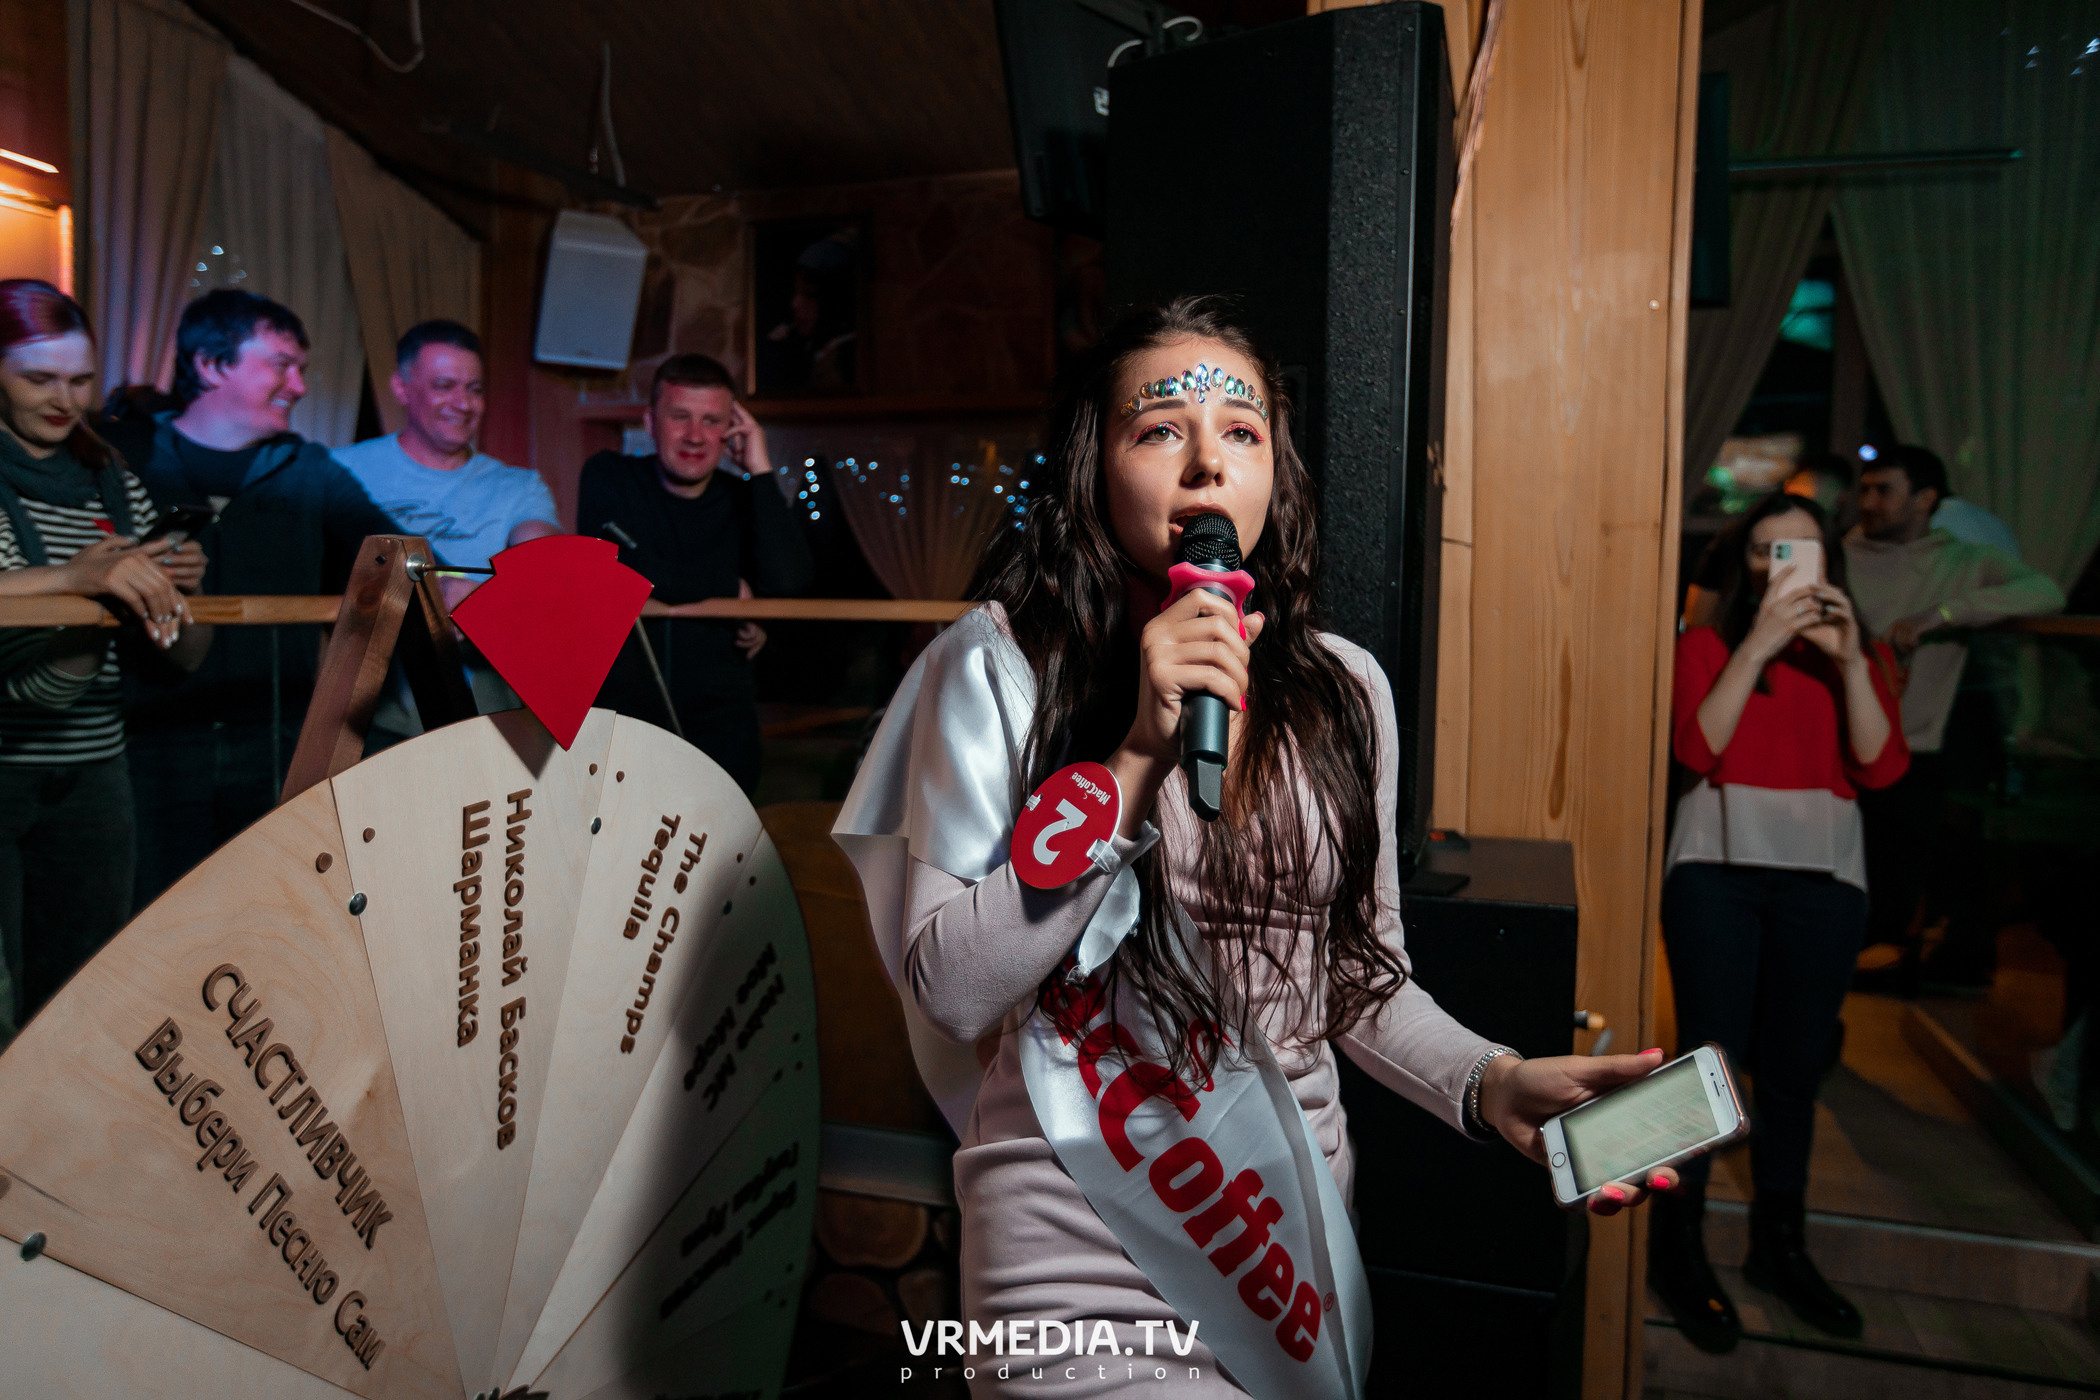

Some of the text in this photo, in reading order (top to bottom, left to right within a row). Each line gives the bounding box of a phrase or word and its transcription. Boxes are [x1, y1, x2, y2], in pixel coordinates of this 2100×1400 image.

[623, 814, 682, 940] Tequila
[1032, 798, 1088, 866] 2
[1071, 771, 1112, 806] MacCoffee
[453, 799, 491, 1048] Шарманка
[497, 788, 533, 1150] Николай Басков
[620, 832, 708, 1054] The Champs
[135, 1016, 386, 1371] Выбери Песню Сам
[202, 963, 394, 1250] СЧАСТЛИВЧИК
[1039, 962, 1323, 1363] acCoffee
